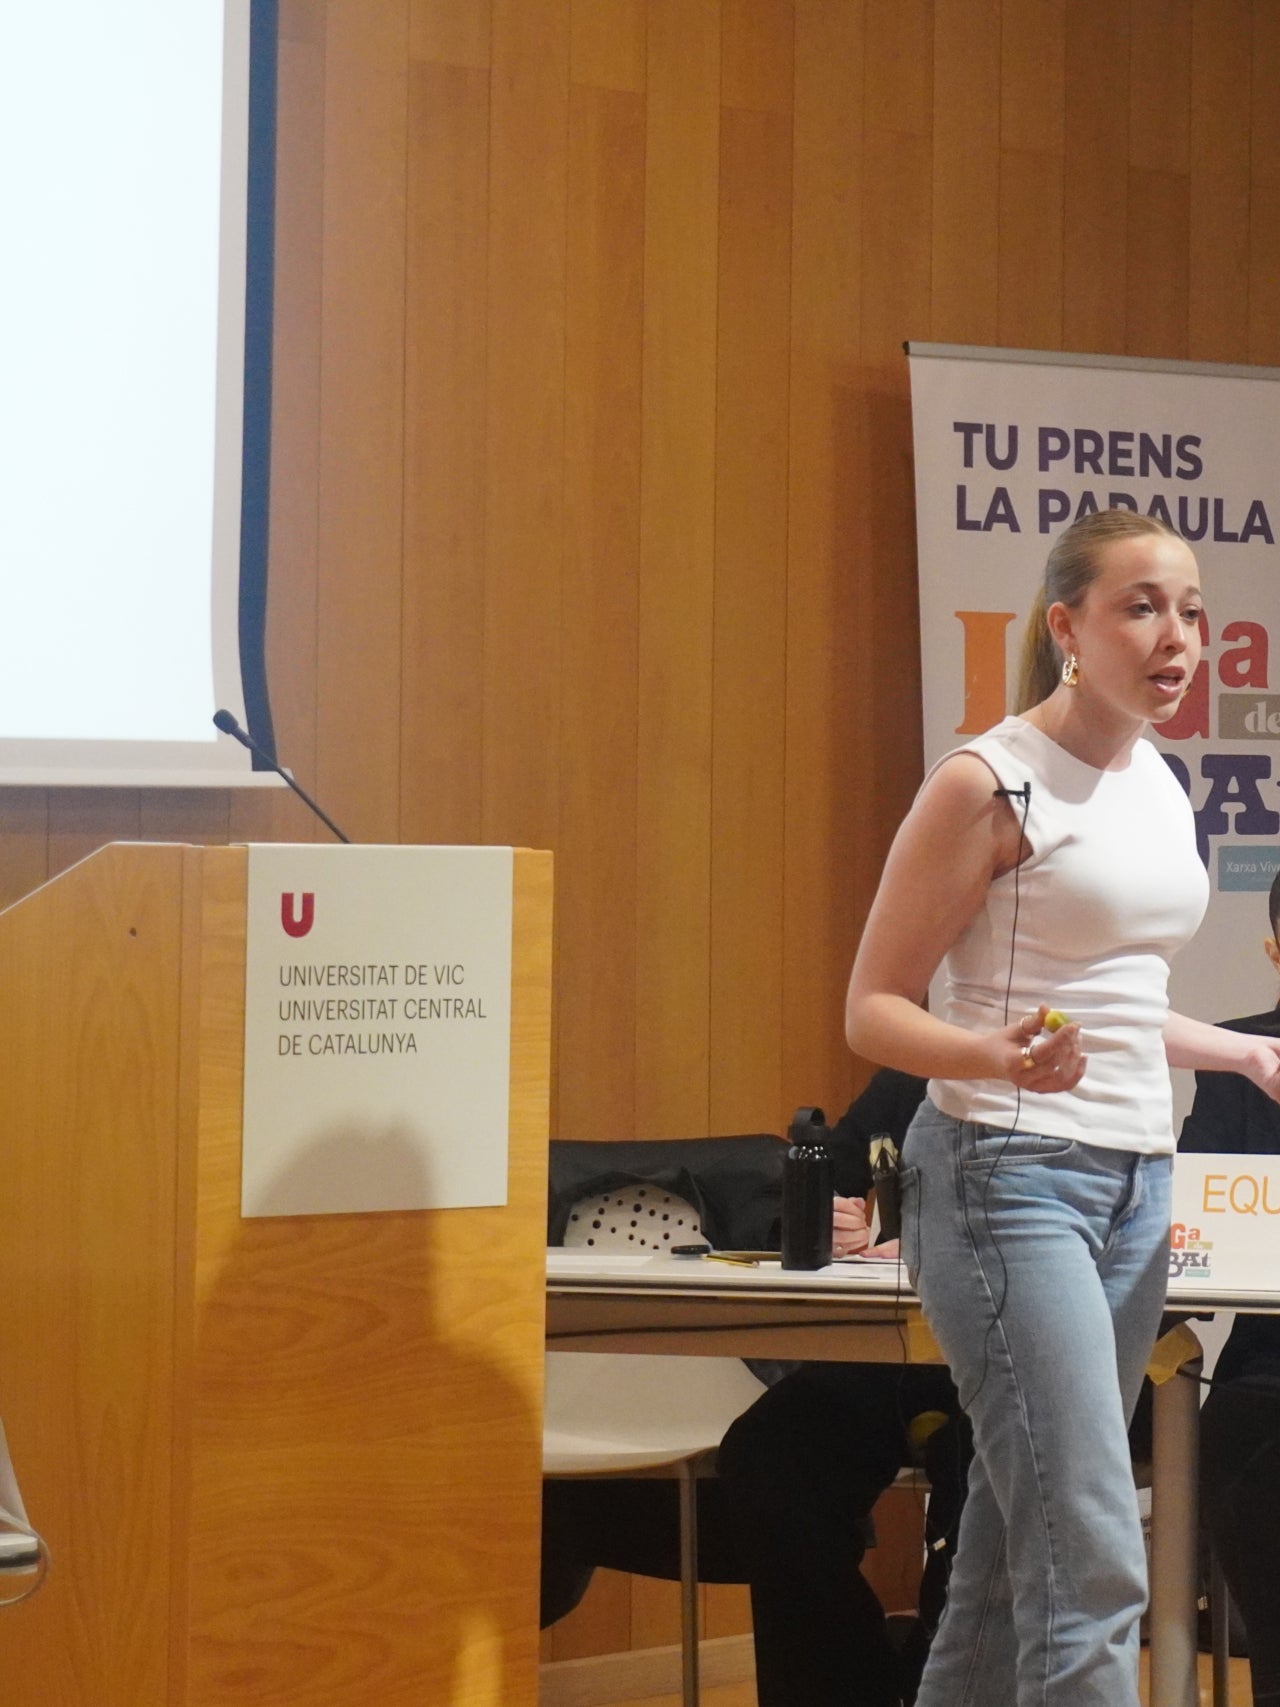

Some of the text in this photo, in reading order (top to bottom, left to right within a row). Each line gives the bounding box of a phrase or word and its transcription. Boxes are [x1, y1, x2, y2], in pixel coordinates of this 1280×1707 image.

[953, 421, 1204, 481] TU PRENS
[956, 484, 1021, 533] LA
[1226, 862, 1257, 873] Xarxa
[281, 893, 315, 938] U
[279, 965, 464, 987] UNIVERSITAT DE VIC
[279, 998, 487, 1021] UNIVERSITAT CENTRAL
[278, 1033, 418, 1055] DE CATALUNYA
